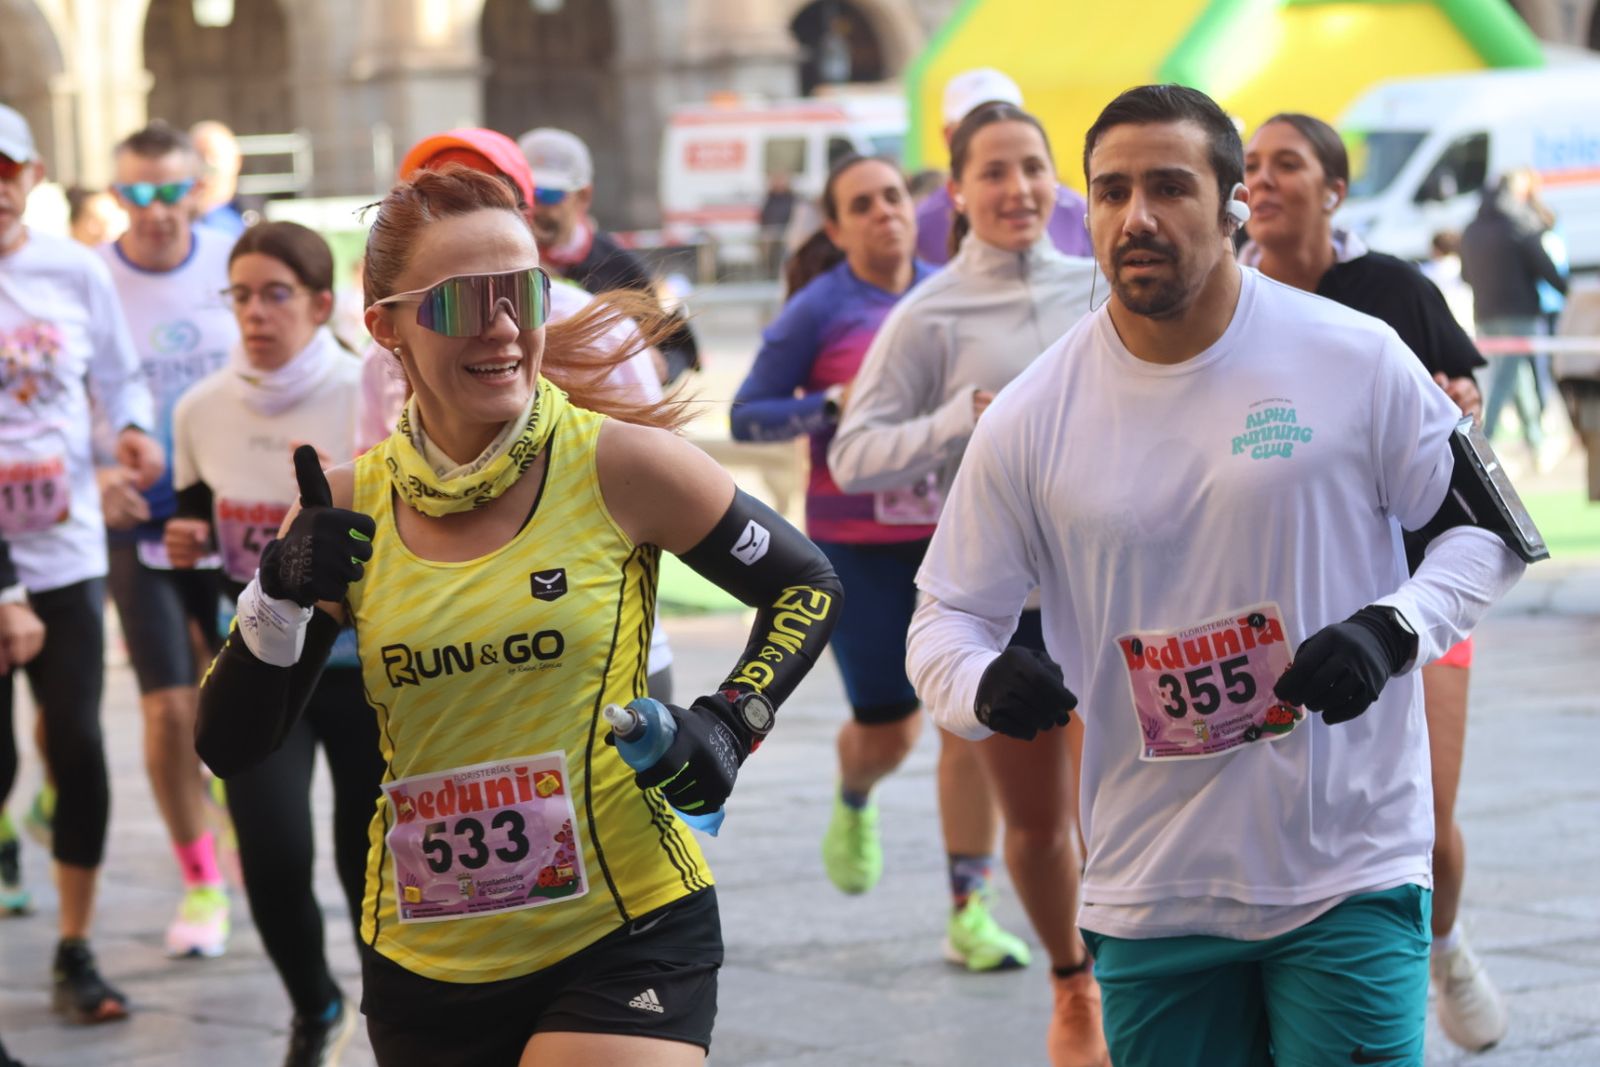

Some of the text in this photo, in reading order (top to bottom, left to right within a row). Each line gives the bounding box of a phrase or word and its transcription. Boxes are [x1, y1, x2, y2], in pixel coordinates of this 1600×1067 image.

[1246, 406, 1297, 430] ALPHA
[1251, 442, 1294, 460] CLUB
[767, 585, 832, 654] RUN
[1119, 617, 1285, 671] bedunia
[381, 629, 565, 688] RUN & GO
[758, 645, 784, 663] &
[1158, 654, 1257, 720] 355
[389, 766, 565, 825] bedunia
[422, 809, 530, 874] 533
[628, 1000, 665, 1013] adidas
